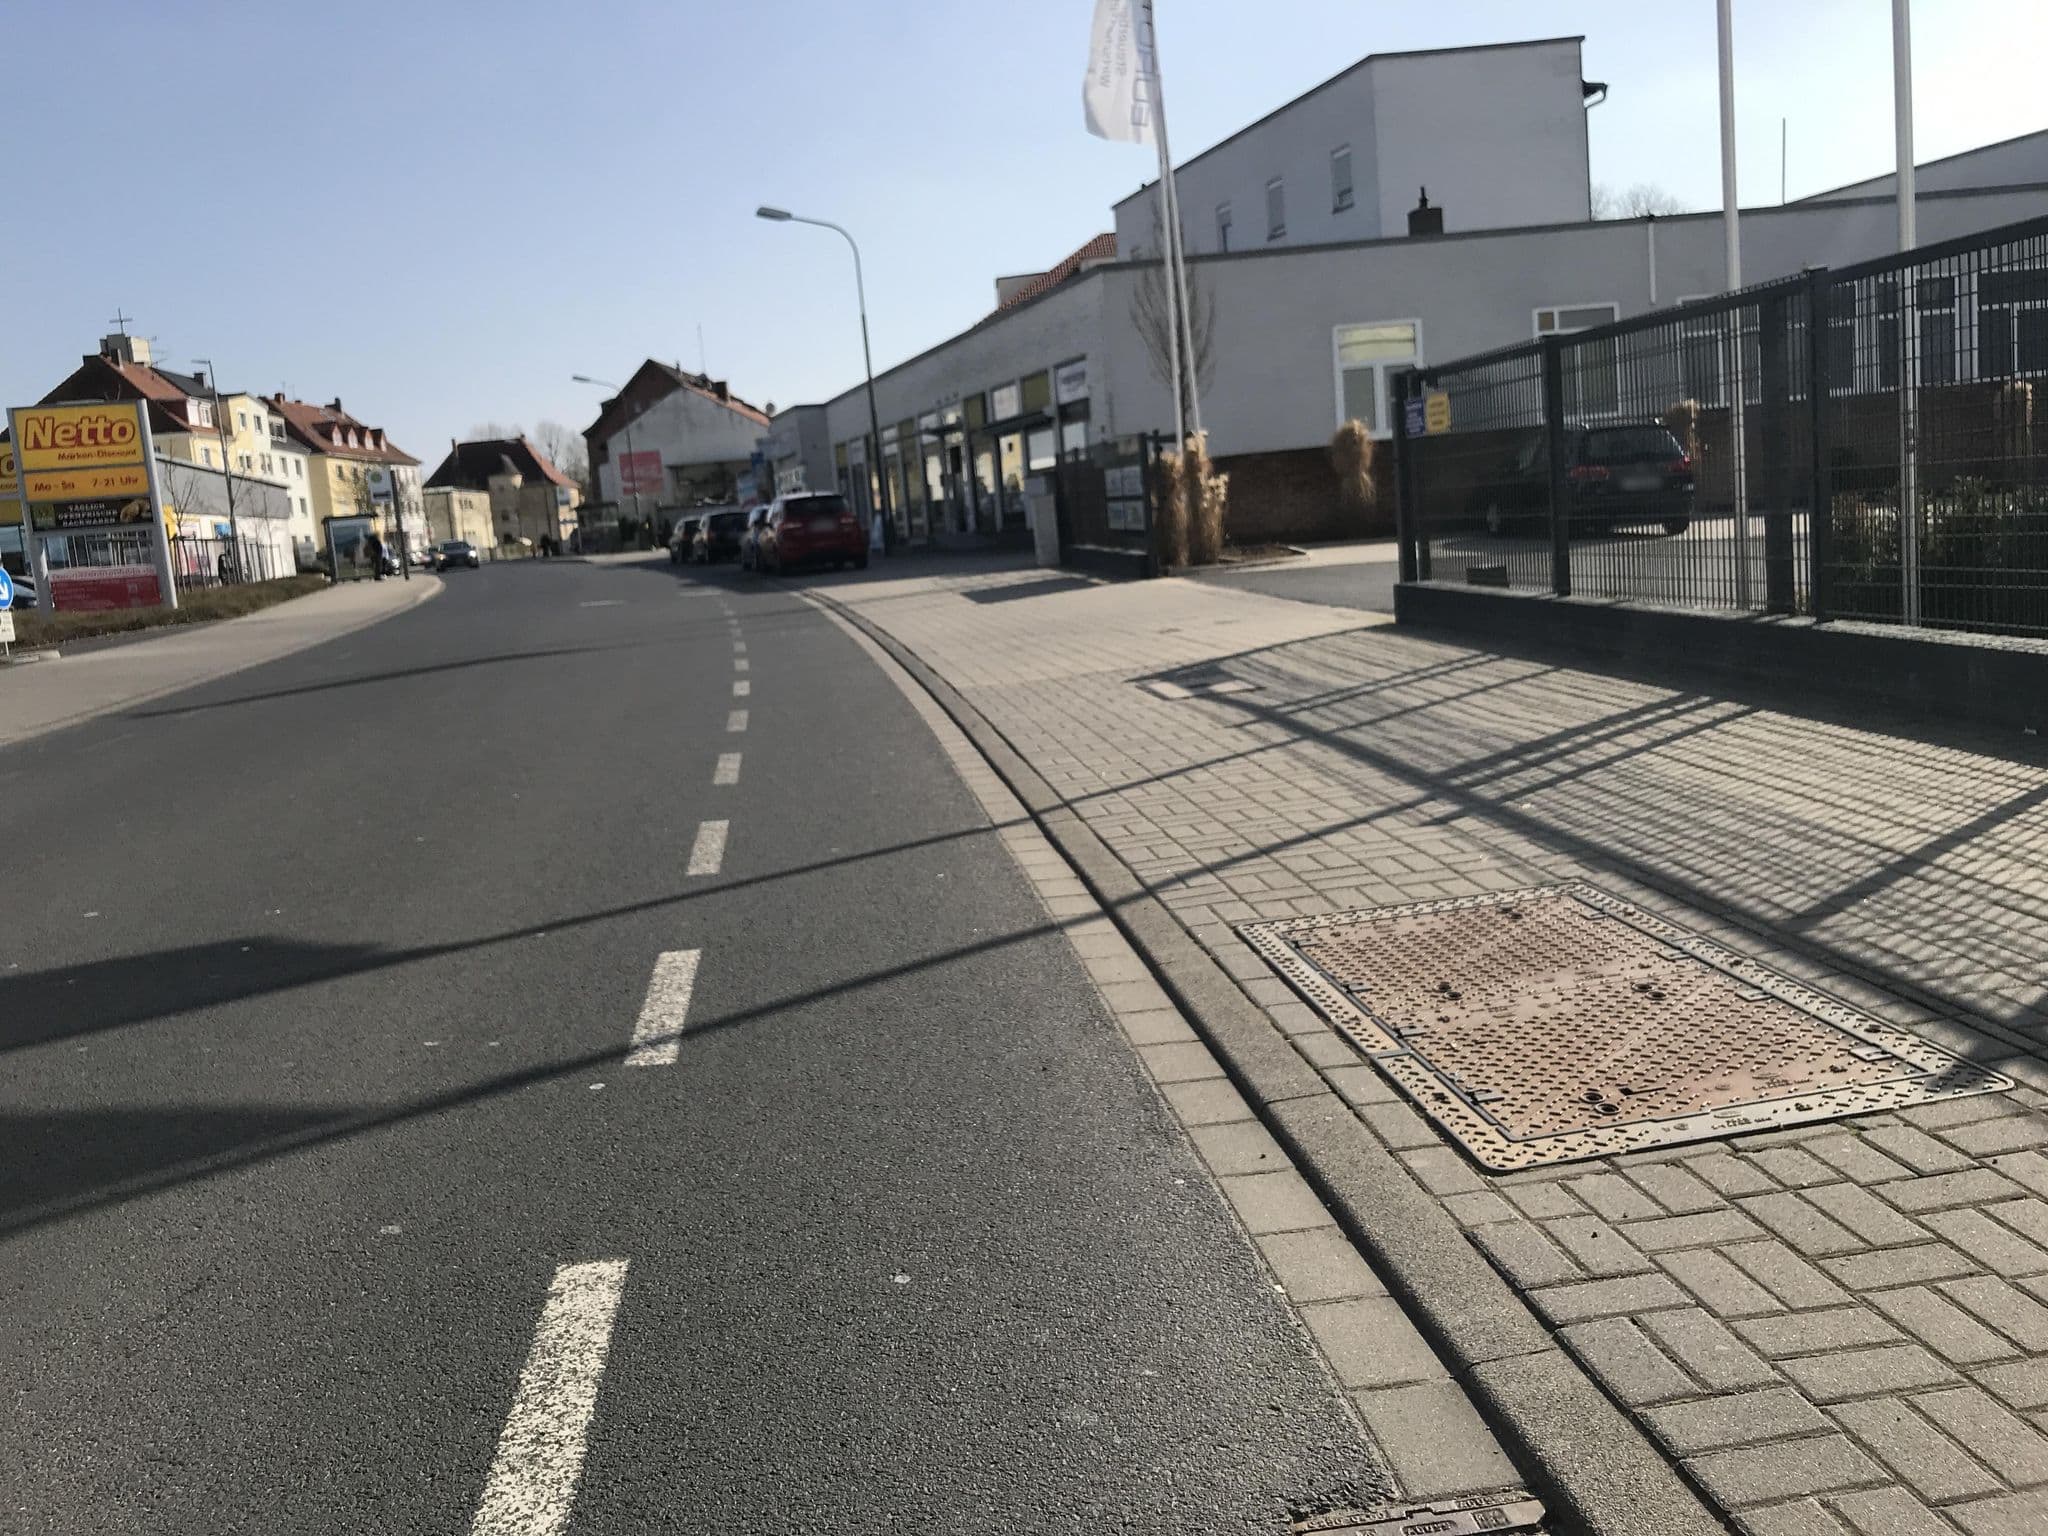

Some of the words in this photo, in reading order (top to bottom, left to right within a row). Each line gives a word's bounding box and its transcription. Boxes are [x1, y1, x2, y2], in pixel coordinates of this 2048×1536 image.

[24, 414, 135, 450] Netto
[34, 481, 52, 492] Mo
[61, 480, 75, 489] Sa
[120, 475, 139, 486] Uhr
